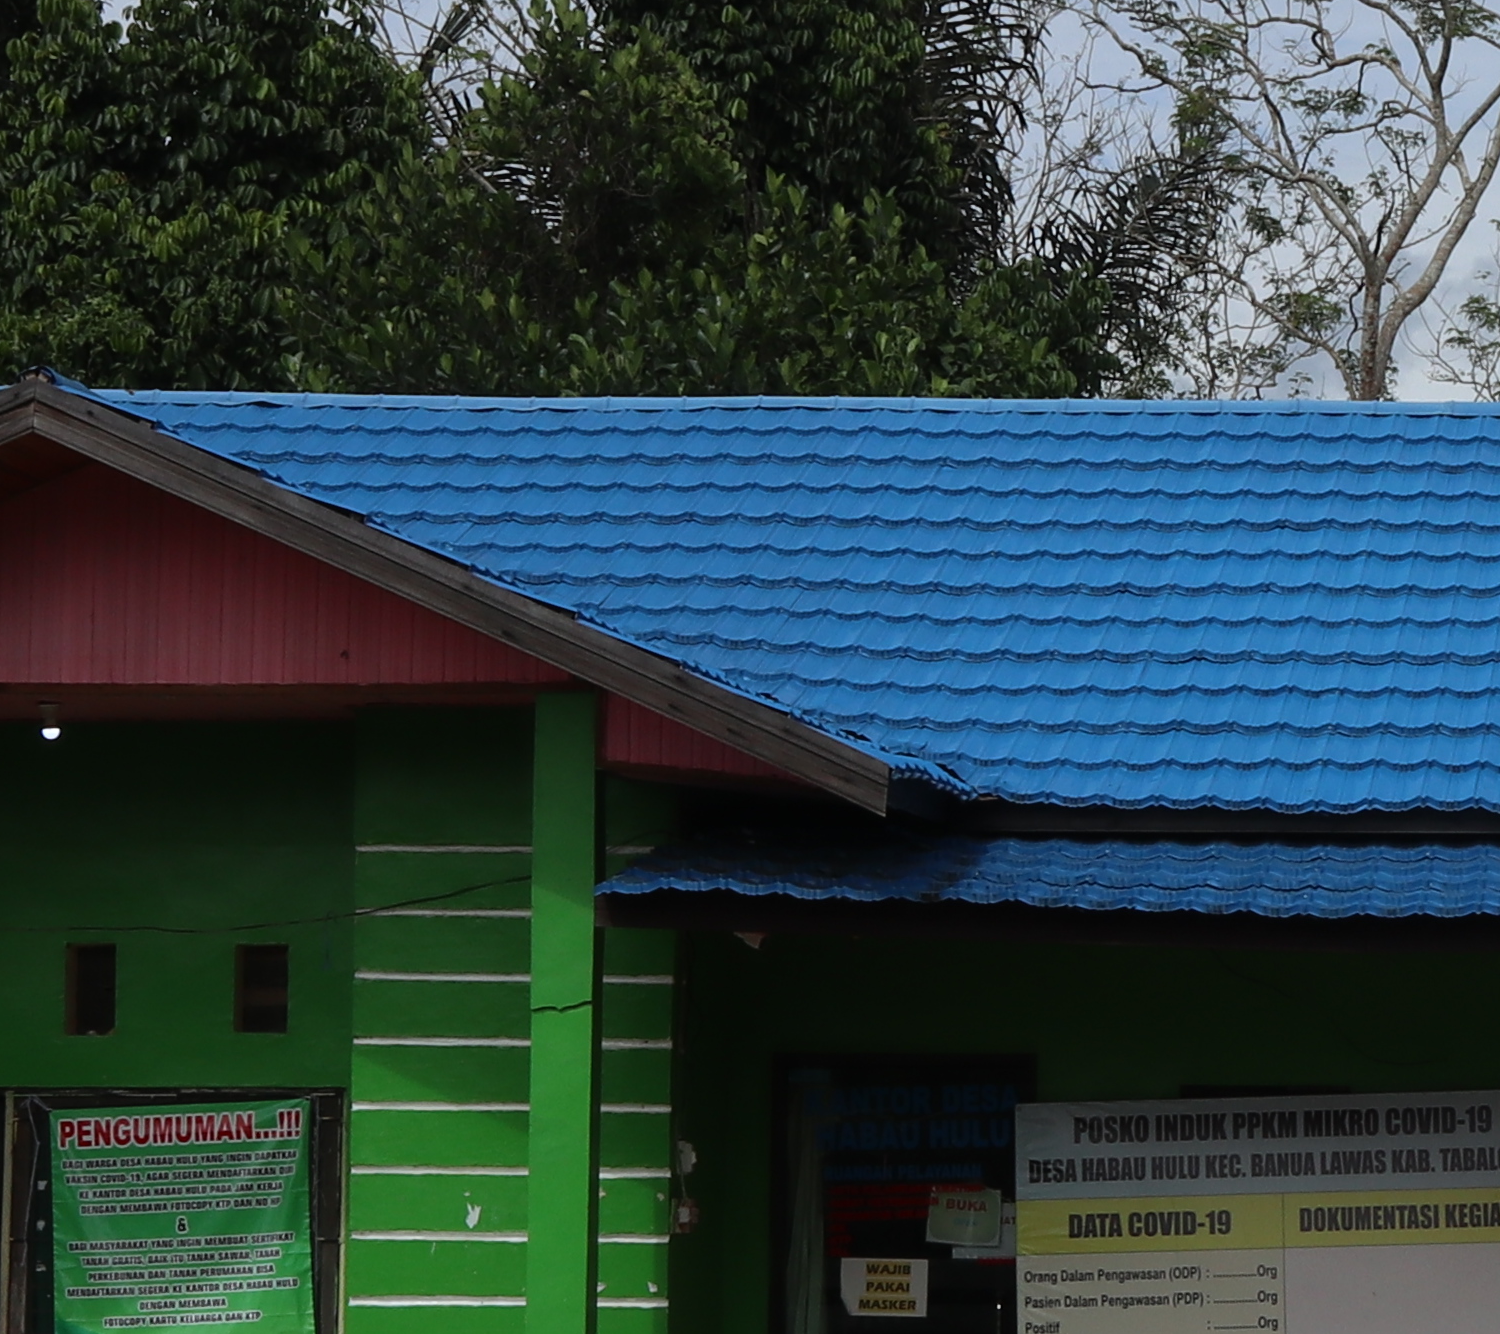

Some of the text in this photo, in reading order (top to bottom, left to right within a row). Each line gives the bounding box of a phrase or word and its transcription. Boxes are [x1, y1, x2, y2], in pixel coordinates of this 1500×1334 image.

[804, 1084, 1019, 1116] KANTOR DESA
[1073, 1105, 1493, 1144] POSKO INDUK PPKM MIKRO COVID-19
[815, 1118, 1012, 1150] HABAU HULU
[62, 1160, 83, 1169] BAGI
[85, 1159, 117, 1169] WARGA
[120, 1157, 141, 1167] DESA
[144, 1156, 174, 1166] HABAU
[176, 1155, 198, 1165] HULU
[201, 1154, 224, 1164] YANG
[226, 1153, 252, 1162] INGIN
[1028, 1158, 1077, 1183] DESA
[1081, 1156, 1146, 1182] HABAU
[1152, 1154, 1200, 1180] HULU
[1205, 1153, 1247, 1179] KEC.
[1251, 1152, 1316, 1178] BANUA
[1320, 1149, 1386, 1175] LAWAS
[1391, 1148, 1435, 1174] KAB.
[65, 1175, 98, 1184] VAKSIN
[100, 1172, 144, 1184] COVID-19,
[146, 1172, 169, 1181] AGAR
[172, 1169, 204, 1180] SEGERA
[207, 1167, 277, 1178] MENDAFTARKAN
[80, 1181, 283, 1199] KE KANTOR DESA HABAU HULU PADA JAM KERJA
[81, 1196, 281, 1214] DENGAN MEMBAWA FOTOCOPY KTP DAN NO HP
[946, 1198, 987, 1212] BUKA
[177, 1217, 187, 1232] &
[1068, 1210, 1232, 1238] DATA COVID-19
[1299, 1204, 1440, 1232] DOKUMENTASI
[68, 1232, 294, 1251] BAGI MASYARAKAT YANG INGIN MEMBUAT SERTIFIKAT
[866, 1264, 911, 1275] WAJIB
[1024, 1271, 1057, 1284] Orang
[1061, 1269, 1094, 1282] Dalam
[1097, 1268, 1166, 1283] Pengawasan
[1169, 1267, 1201, 1281] (ODP)
[866, 1281, 910, 1293] PAKAI
[140, 1298, 226, 1310] DENGAN MEMBAWA
[858, 1298, 916, 1310] MASKER
[1024, 1296, 1061, 1308] Pasien
[1064, 1295, 1098, 1307] Dalam
[1101, 1294, 1169, 1308] Pengawasan
[1173, 1292, 1204, 1307] (PDP)
[104, 1310, 261, 1327] FOTOCOPY KARTU KELUARGA DAN KTP
[1025, 1322, 1060, 1334] Positif
